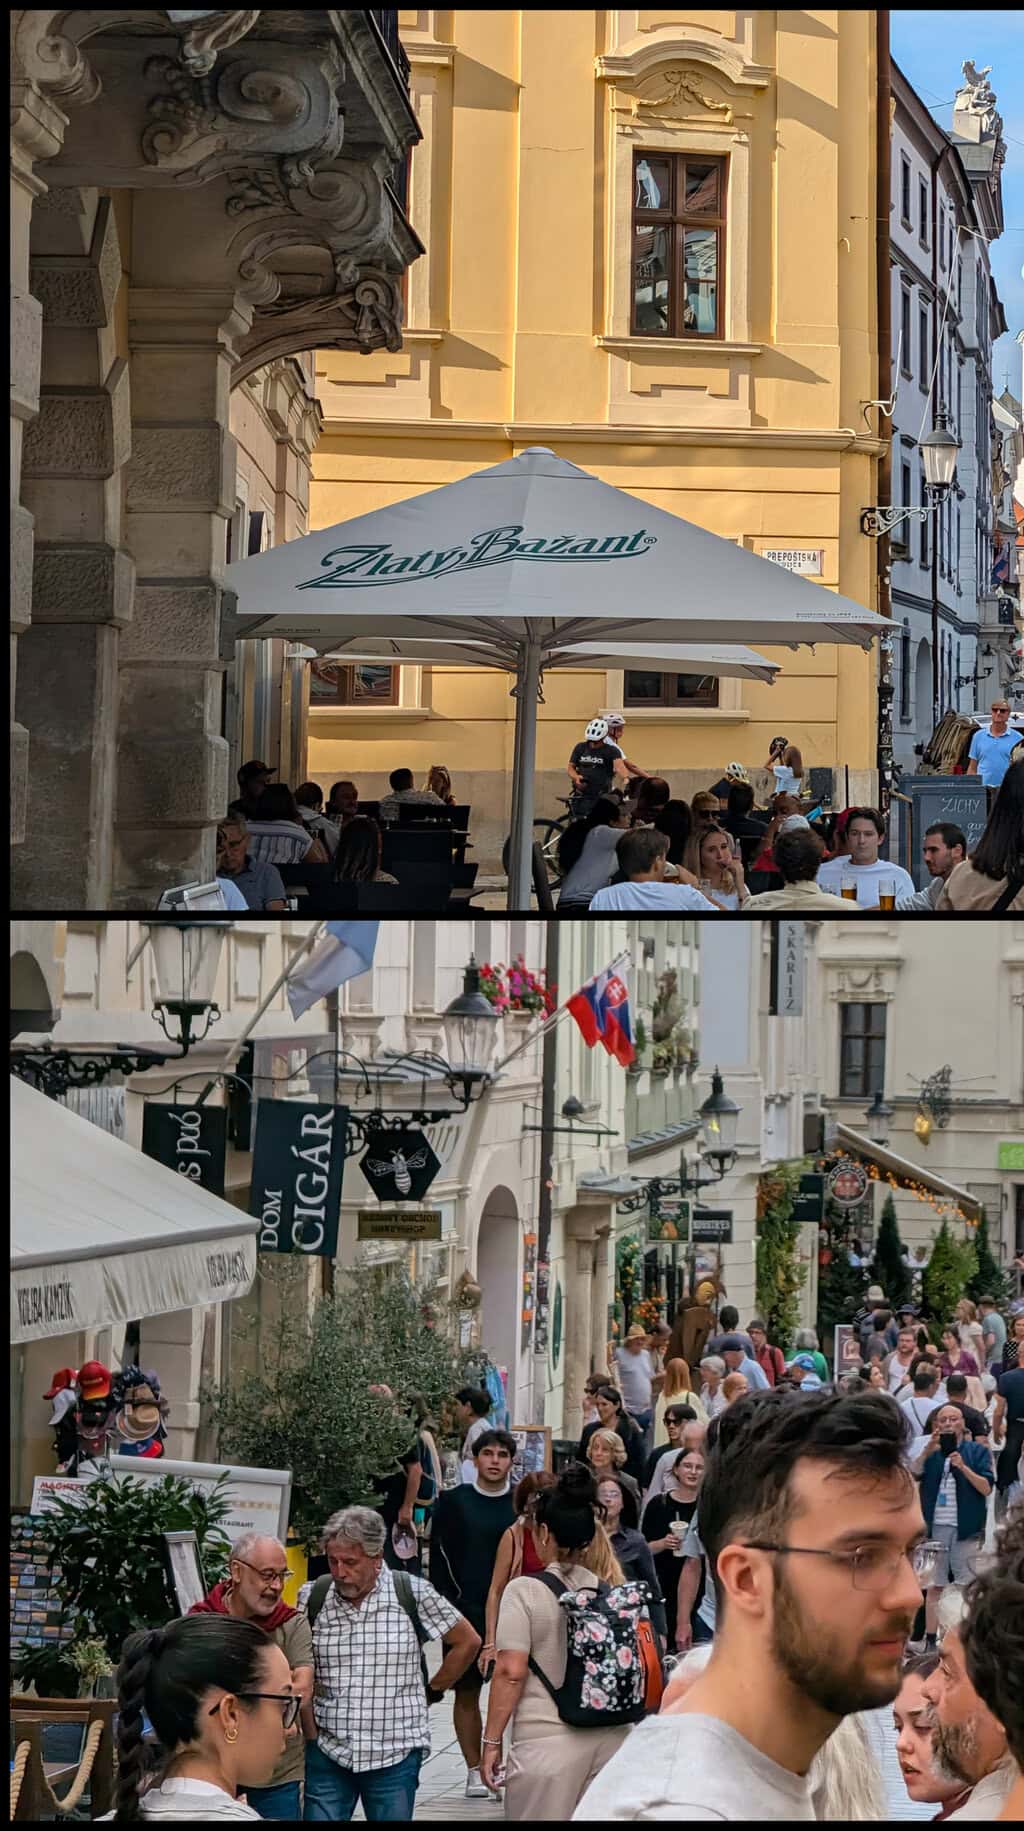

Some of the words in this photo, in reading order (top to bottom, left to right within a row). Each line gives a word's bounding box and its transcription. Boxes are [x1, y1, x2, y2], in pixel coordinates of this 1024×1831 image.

[296, 544, 464, 590] Zlatý
[290, 1108, 335, 1251] CIGÁR
[260, 1189, 283, 1248] DOM
